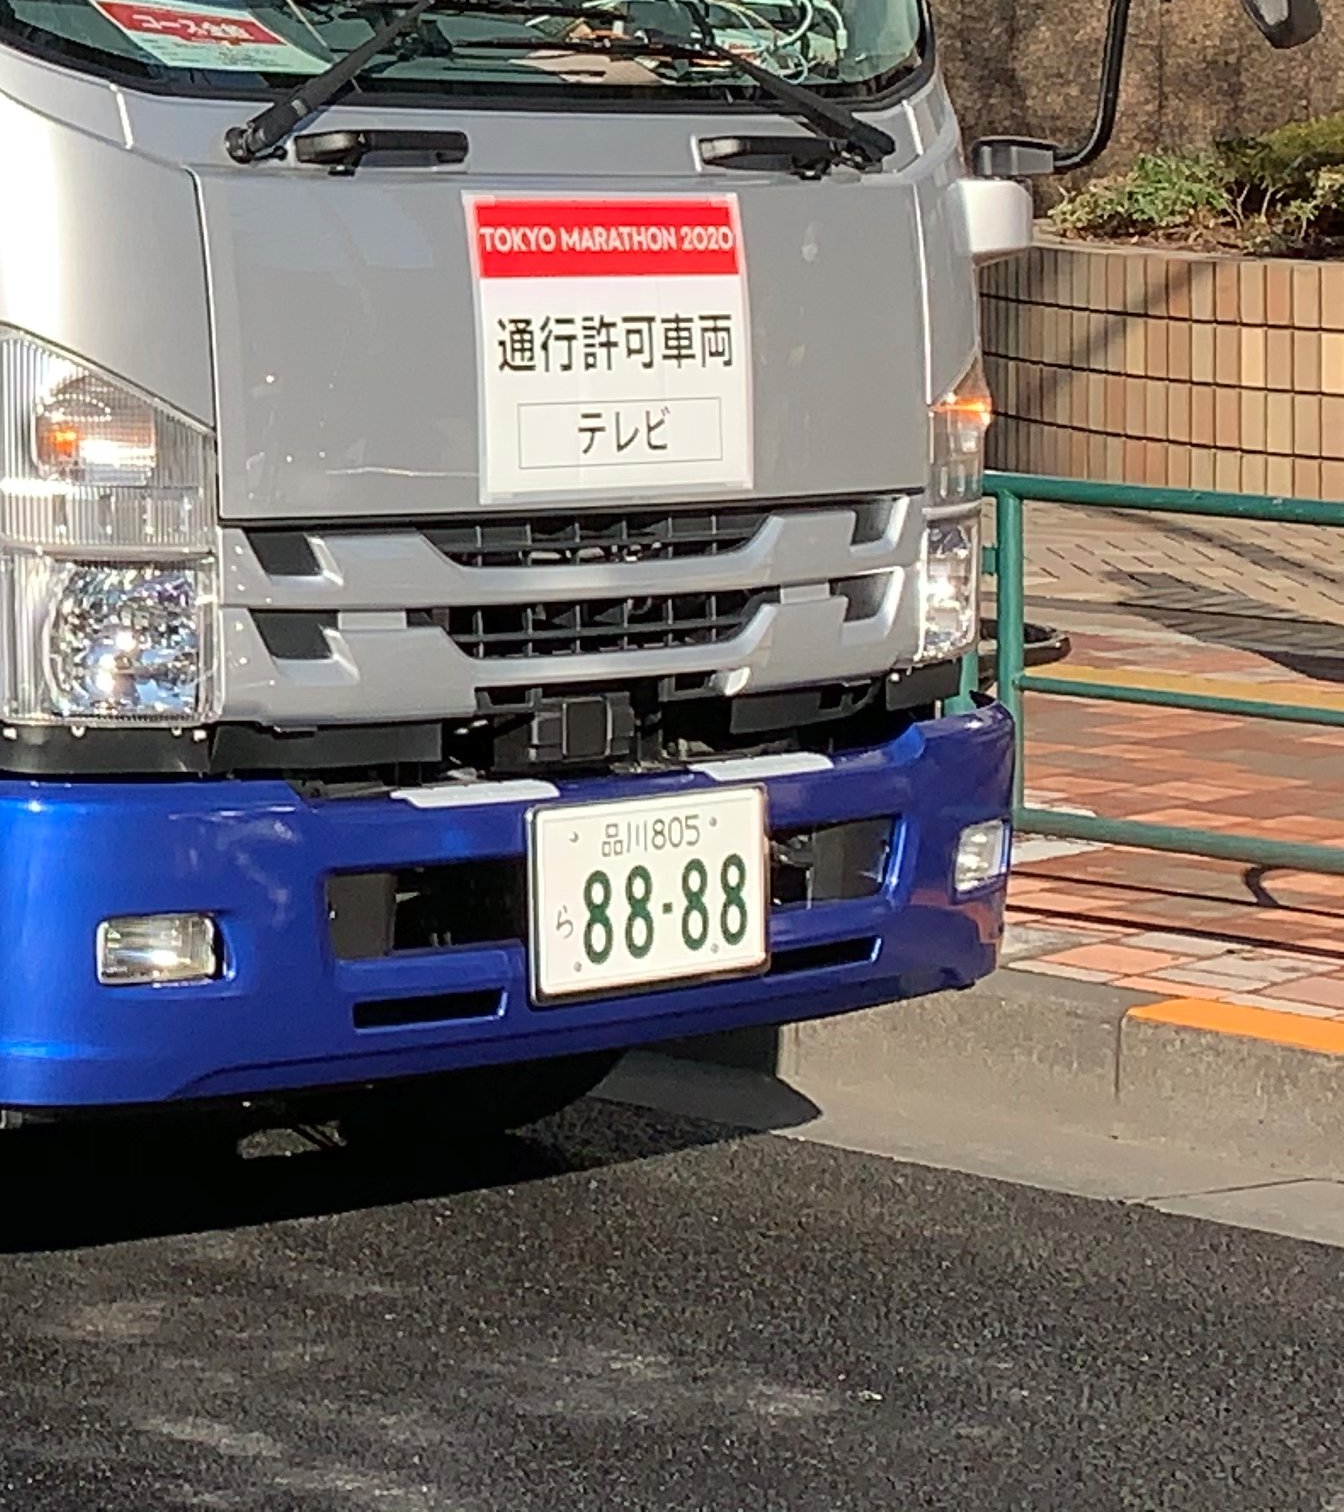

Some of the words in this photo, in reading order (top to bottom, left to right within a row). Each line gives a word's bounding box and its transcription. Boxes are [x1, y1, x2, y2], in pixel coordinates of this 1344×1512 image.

[478, 226, 557, 253] TOKYO
[560, 226, 677, 252] MARATHON
[680, 225, 735, 252] 2020
[497, 312, 734, 372] 通行許可車両
[577, 405, 670, 455] テレビ
[555, 904, 574, 939] ら
[583, 853, 748, 965] 88-88
